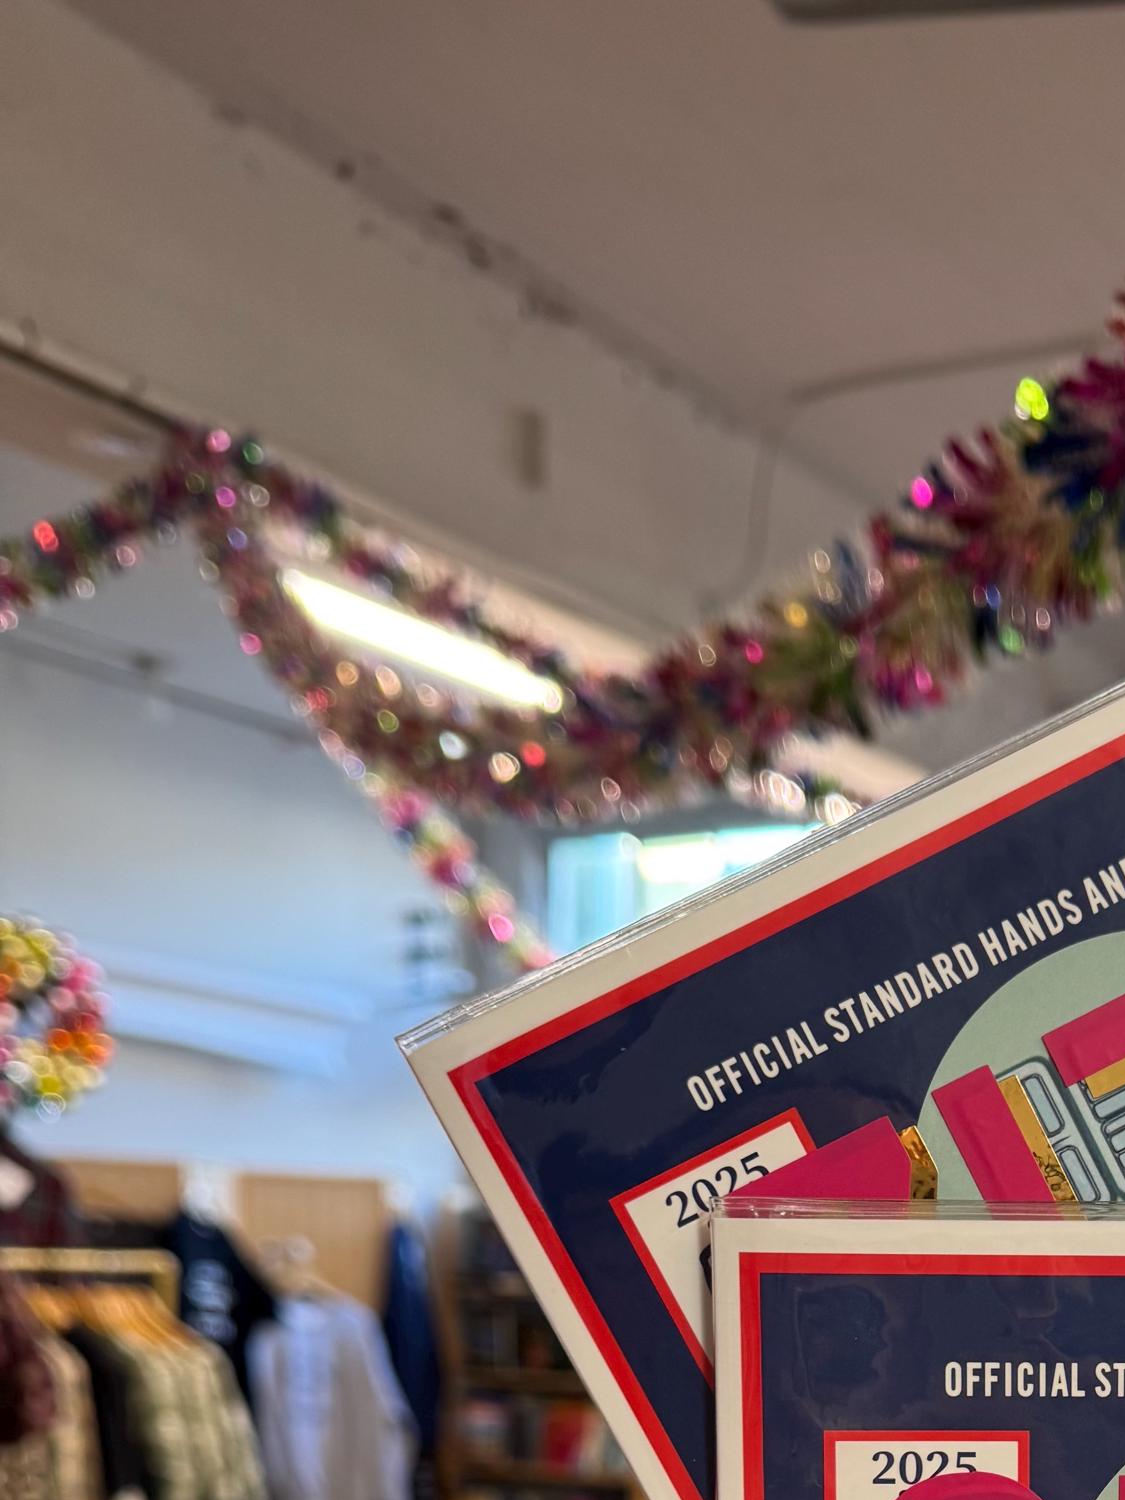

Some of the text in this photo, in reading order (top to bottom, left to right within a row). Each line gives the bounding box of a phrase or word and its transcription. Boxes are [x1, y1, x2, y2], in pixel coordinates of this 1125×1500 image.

[687, 1036, 829, 1113] OFFICIAL
[826, 942, 981, 1044] STANDARD
[979, 889, 1084, 968] HANDS
[944, 1361, 1086, 1397] OFFICIAL
